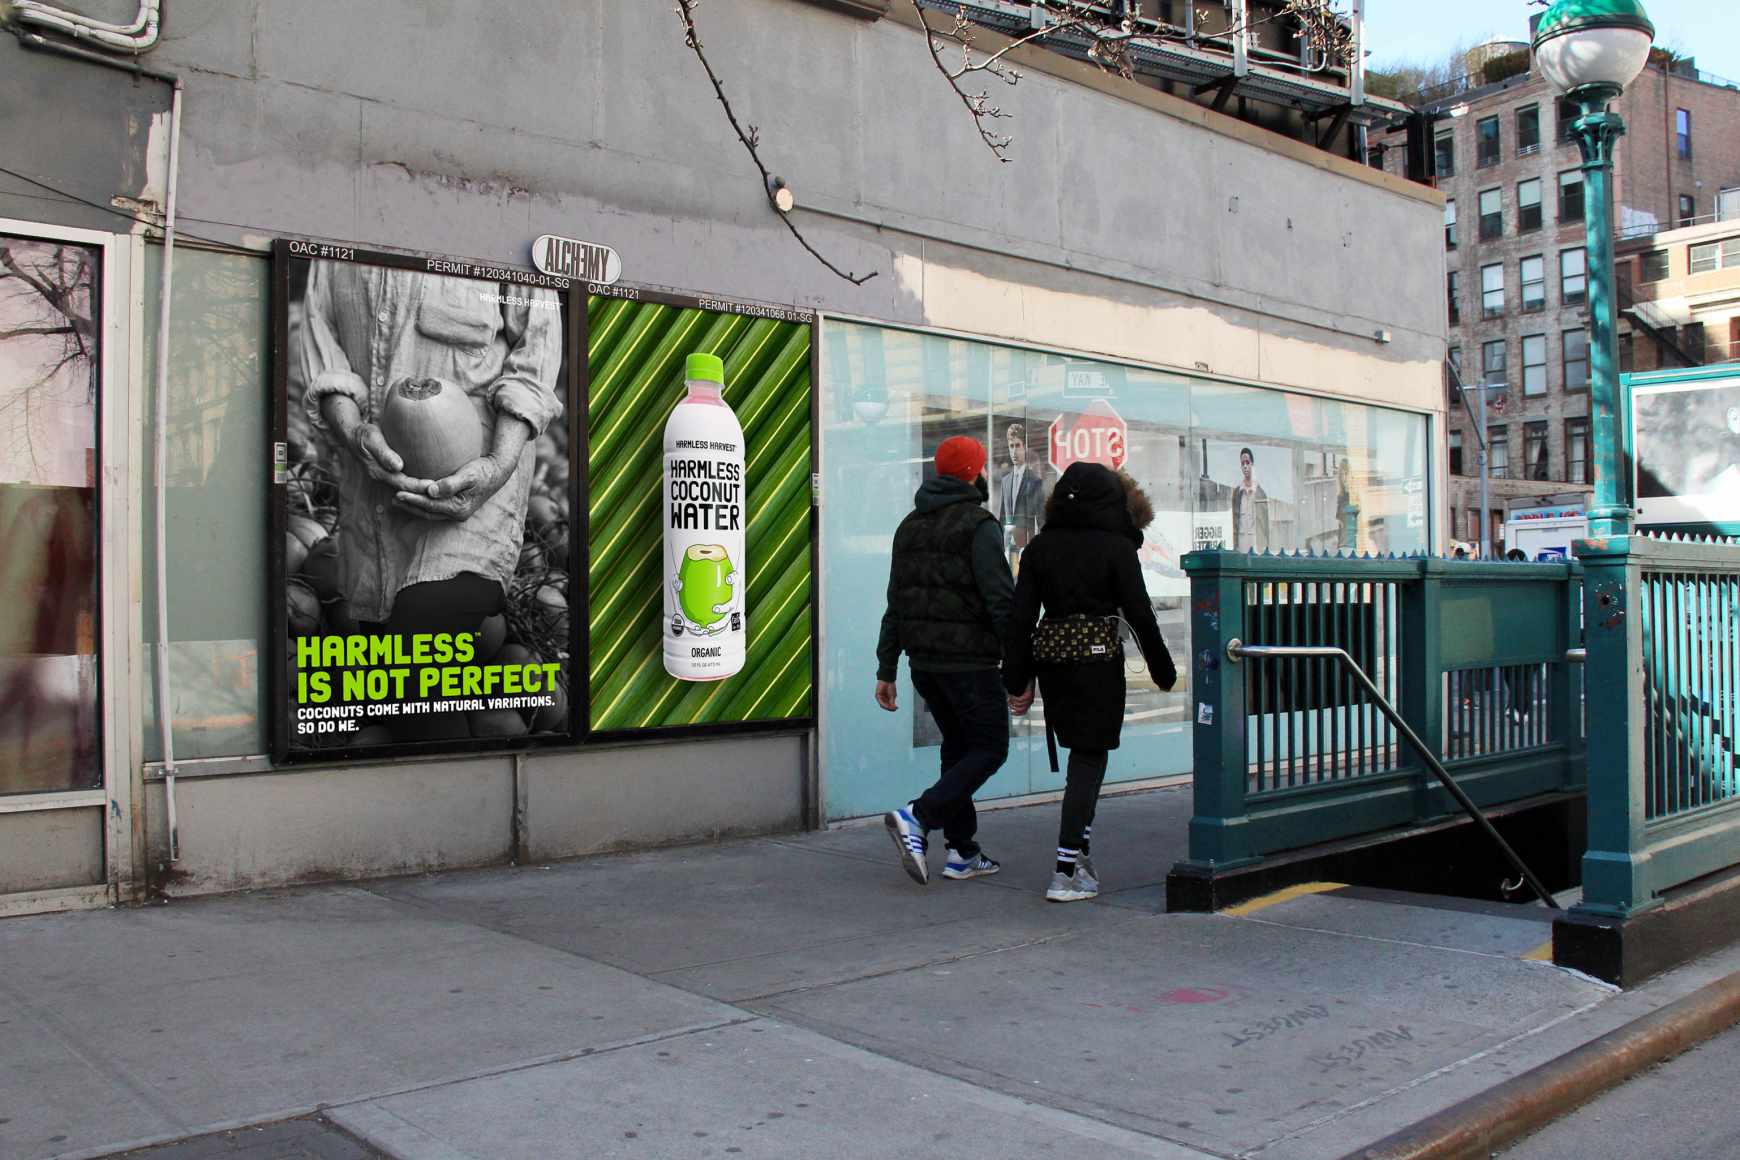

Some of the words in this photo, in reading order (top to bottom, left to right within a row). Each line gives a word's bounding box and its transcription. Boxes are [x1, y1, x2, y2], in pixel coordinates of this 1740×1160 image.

[289, 241, 318, 255] OAC
[320, 245, 354, 260] #1121
[545, 237, 610, 282] ALCHEMY
[427, 259, 471, 275] PERMIT
[473, 266, 570, 289] #120341040-01-SG
[588, 283, 610, 296] OAC
[613, 287, 640, 300] #1121
[699, 299, 733, 312] PERMIT
[676, 440, 709, 449] HARMLESS
[709, 442, 737, 452] HARVEST
[671, 460, 740, 481] HARMLESS
[671, 481, 740, 503] COCONUT
[671, 503, 740, 530] WATER
[691, 647, 721, 658] ORGANIC
[297, 671, 331, 704] IS
[343, 668, 410, 701] NOT
[420, 663, 561, 698] PERFECT
[297, 705, 364, 720] COCONUTS
[367, 703, 400, 717] COME
[402, 702, 430, 714] WITH
[433, 699, 485, 713] NATURAL
[488, 695, 556, 710] VARIATIONS.
[297, 722, 315, 735] SO
[318, 721, 335, 733] DO
[338, 720, 360, 732] WE.
